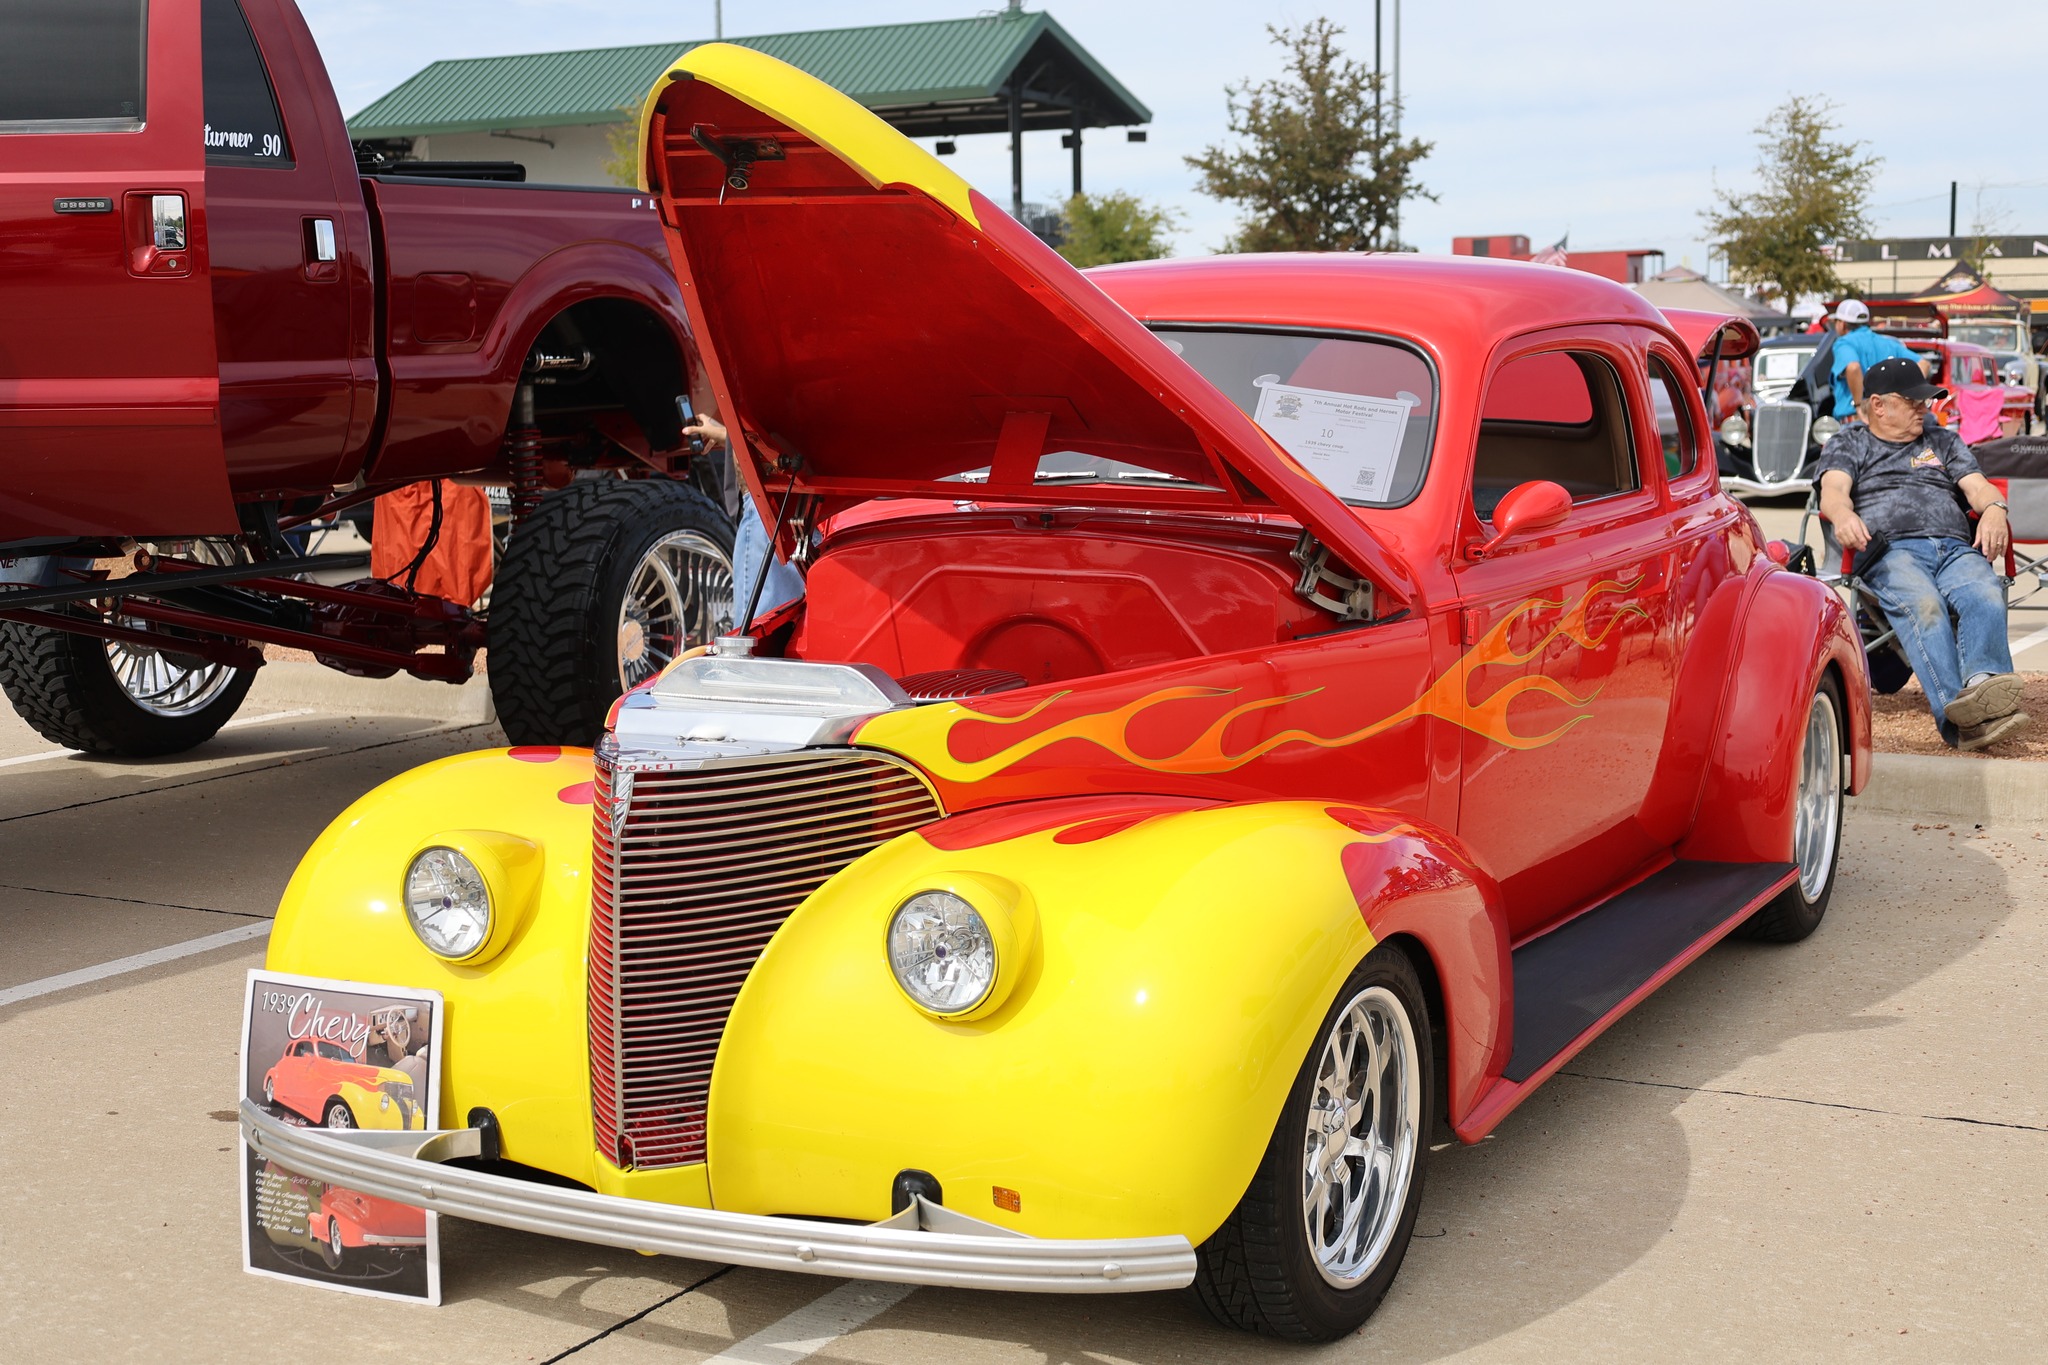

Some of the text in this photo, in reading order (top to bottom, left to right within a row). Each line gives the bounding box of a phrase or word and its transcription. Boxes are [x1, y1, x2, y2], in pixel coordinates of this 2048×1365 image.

[203, 123, 253, 148] turner
[1352, 410, 1374, 418] Festival
[1320, 428, 1334, 438] 10
[261, 991, 371, 1058] 1939 Chevy
